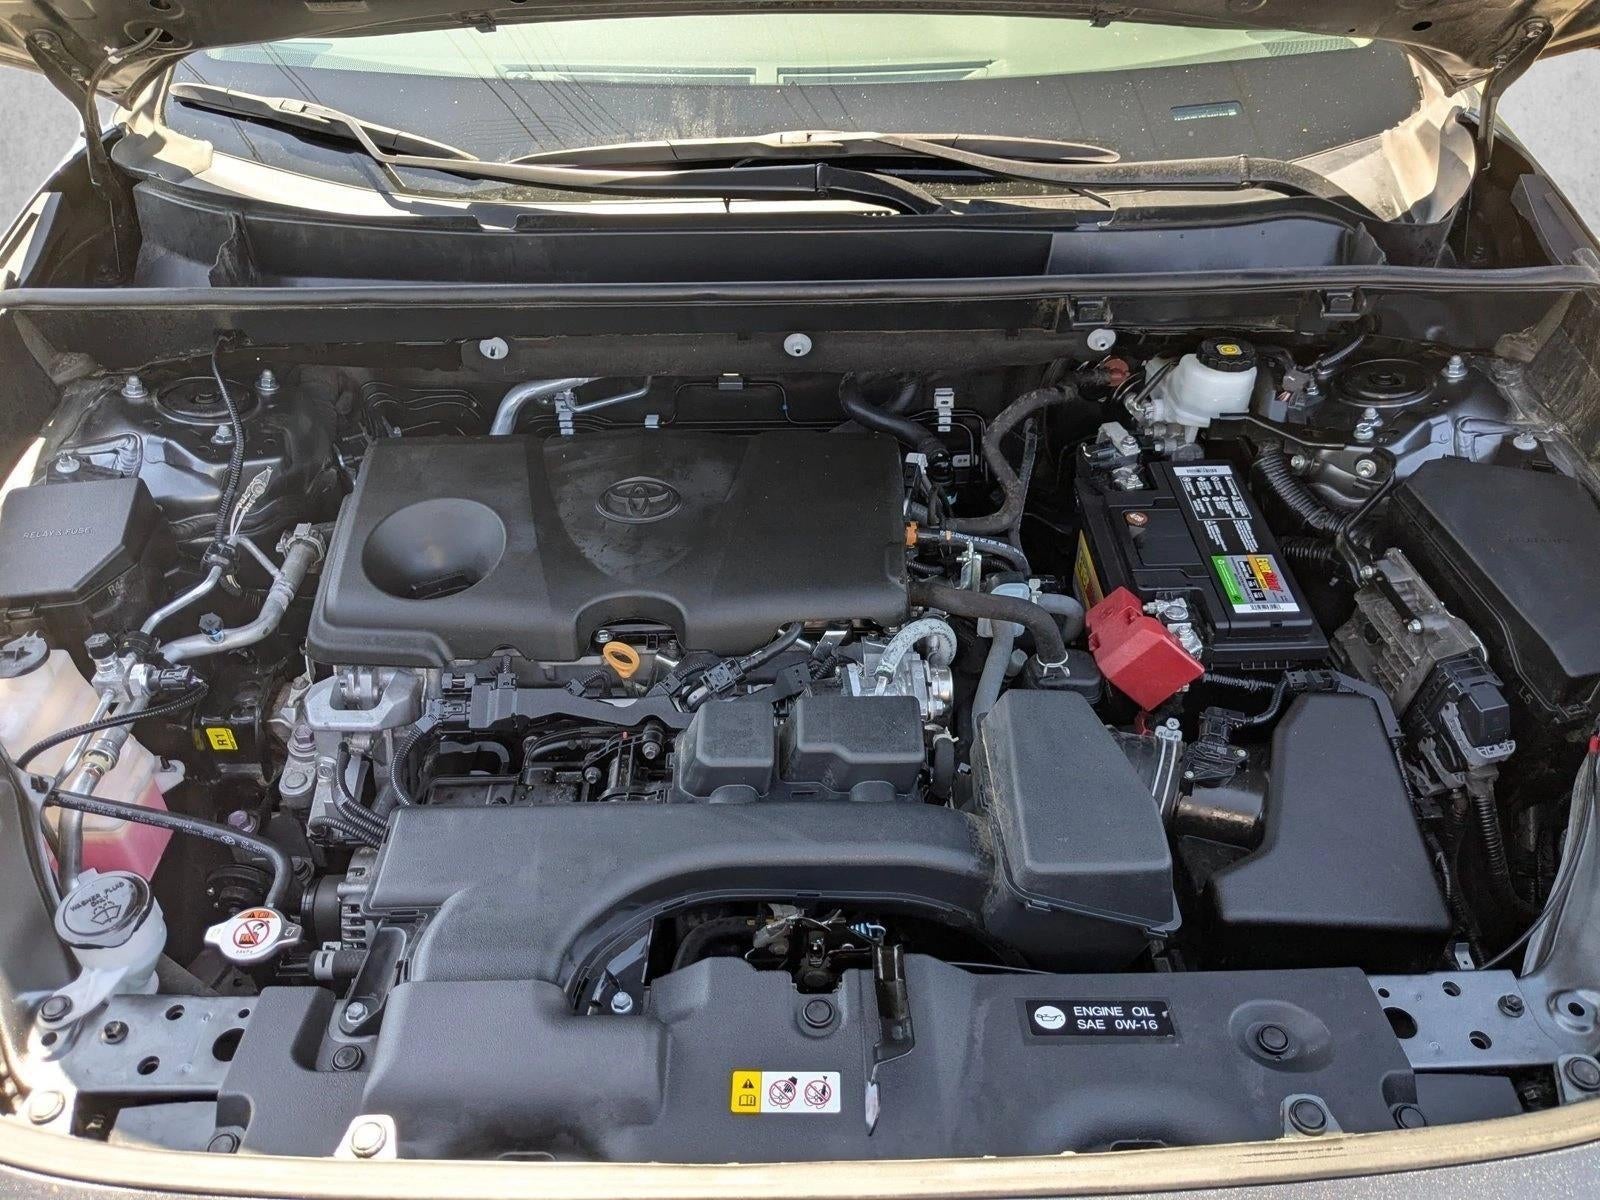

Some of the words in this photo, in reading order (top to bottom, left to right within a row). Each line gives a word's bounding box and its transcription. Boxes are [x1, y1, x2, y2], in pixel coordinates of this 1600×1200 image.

[23, 530, 55, 539] RELAY
[65, 526, 93, 535] FUSE
[215, 734, 229, 746] R1
[70, 893, 101, 911] WASHER
[104, 881, 125, 895] FLUID
[91, 894, 109, 907] ONLY
[1073, 1006, 1124, 1017] ENGINE
[1131, 1006, 1156, 1017] OIL
[1077, 1019, 1106, 1030] SAE
[1115, 1019, 1158, 1030] 0W-16
